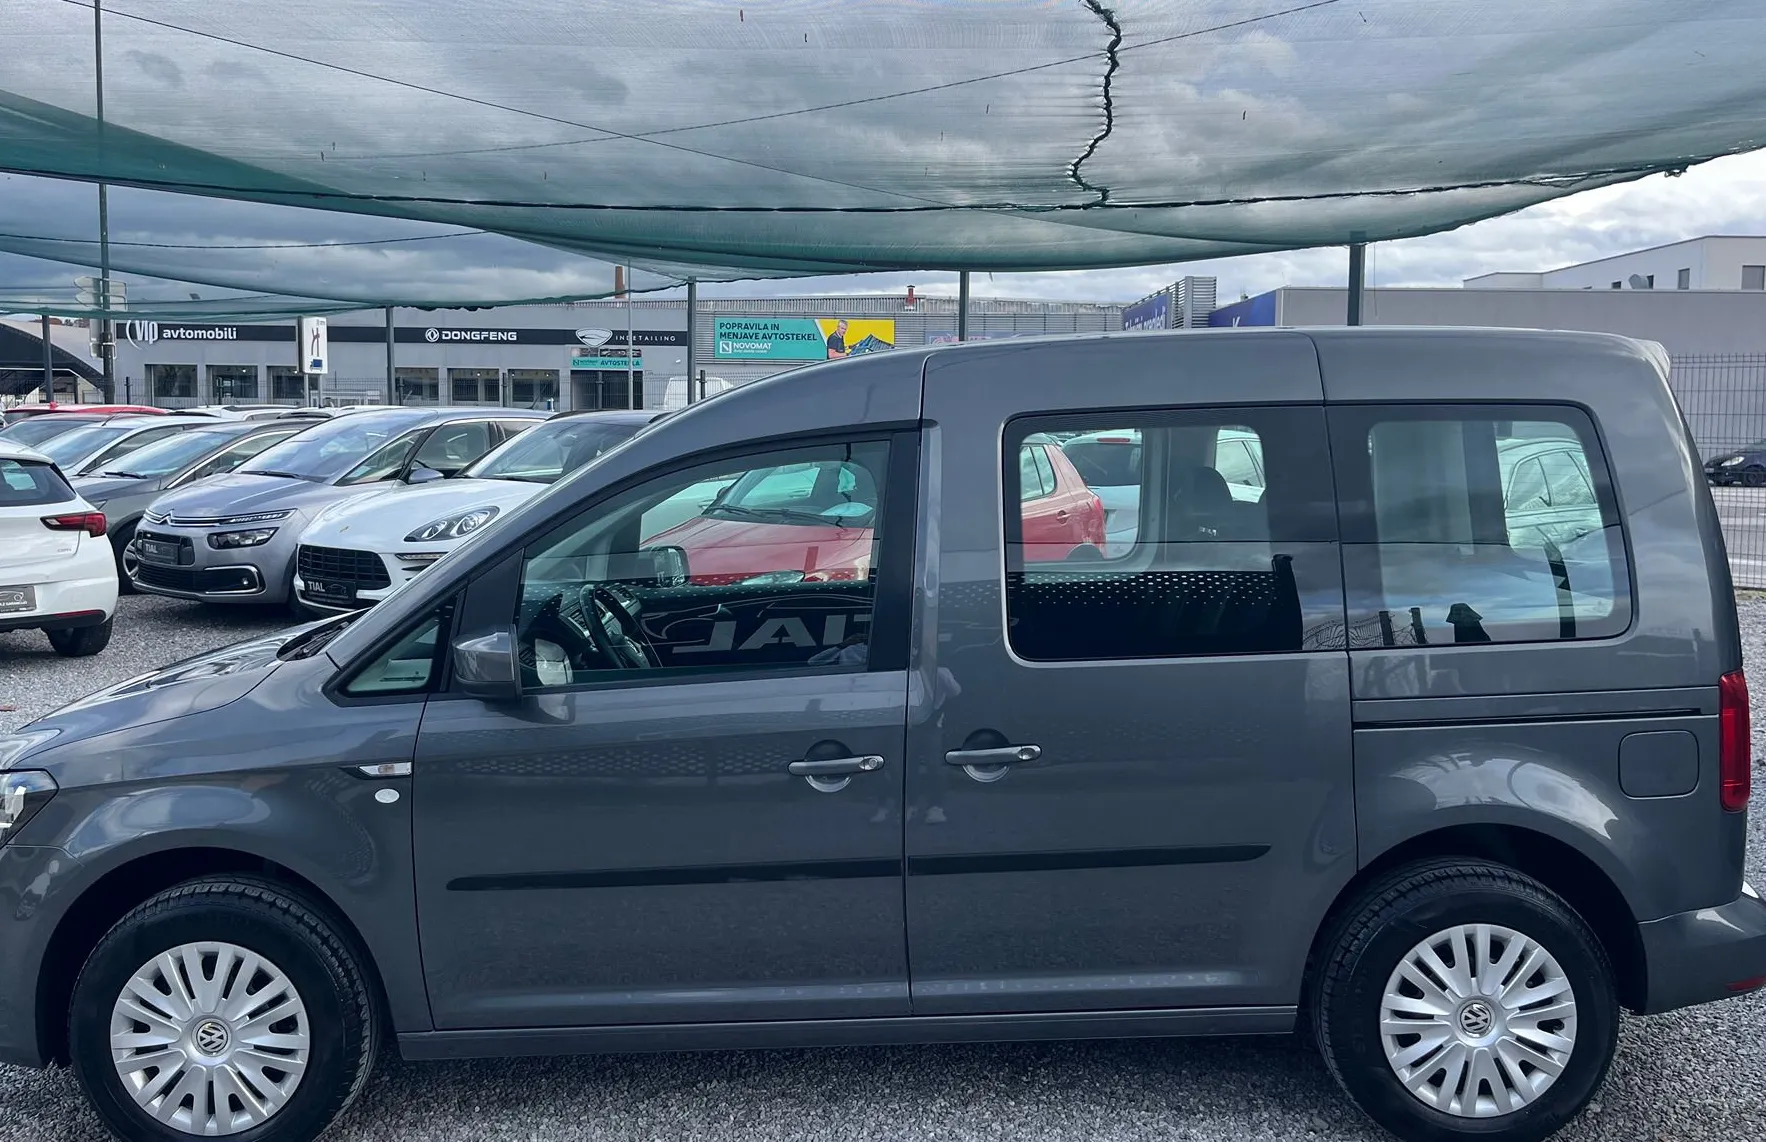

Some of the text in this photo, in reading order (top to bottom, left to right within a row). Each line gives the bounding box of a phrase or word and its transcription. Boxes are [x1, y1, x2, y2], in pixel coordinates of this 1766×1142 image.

[719, 322, 780, 331] POPRAVILA IN
[163, 327, 237, 340] avtomobili
[441, 330, 518, 341] DONGFENG
[719, 332, 818, 341] MENJAVE AVTOSTEKEL
[733, 342, 772, 350] NOVOMAT
[307, 580, 326, 592] TIAL
